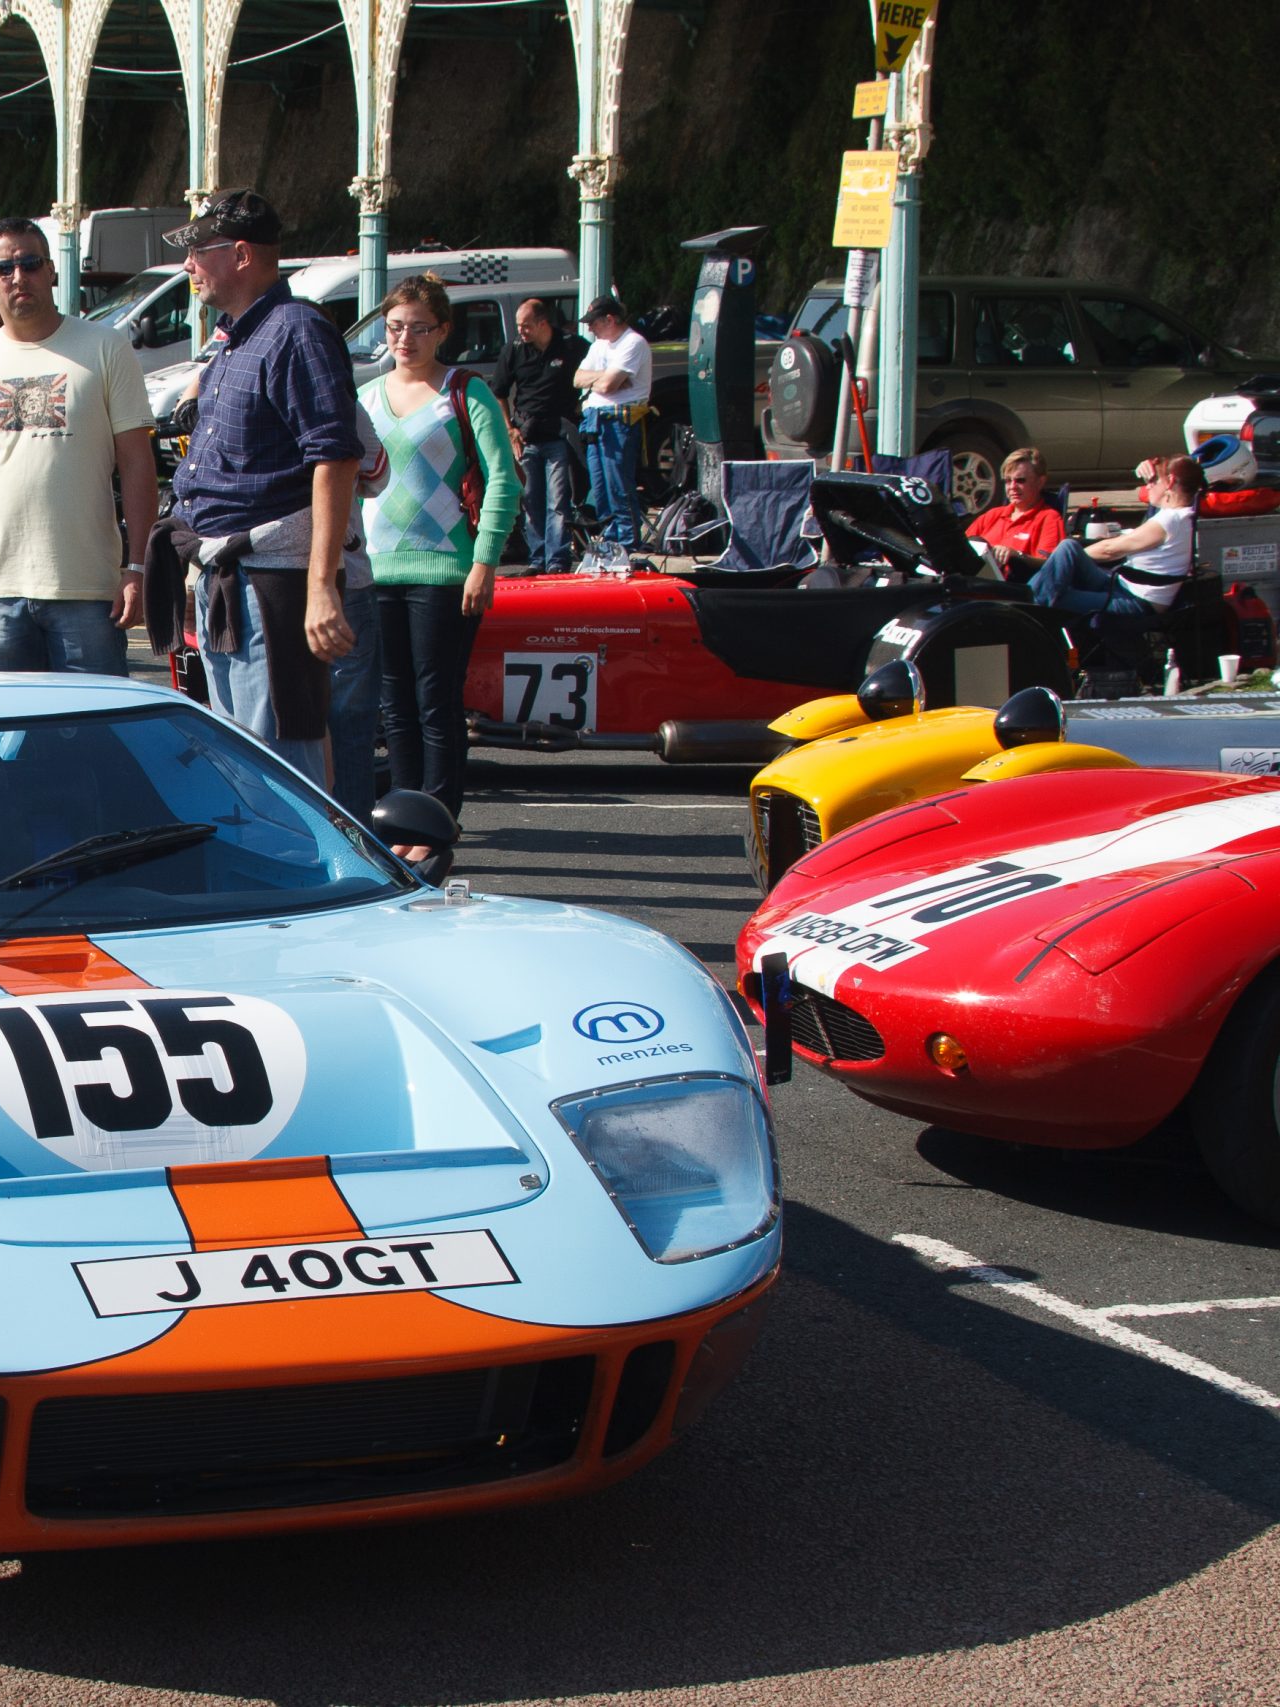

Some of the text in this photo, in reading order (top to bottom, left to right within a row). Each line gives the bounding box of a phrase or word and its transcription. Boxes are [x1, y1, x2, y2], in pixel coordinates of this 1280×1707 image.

[877, 2, 925, 28] HERE
[737, 258, 752, 285] P
[526, 635, 579, 644] OMEX
[505, 663, 588, 731] 73
[870, 861, 1063, 924] 70
[774, 915, 860, 945] N838
[596, 1042, 694, 1066] menzies
[156, 1241, 439, 1303] J 40GT
